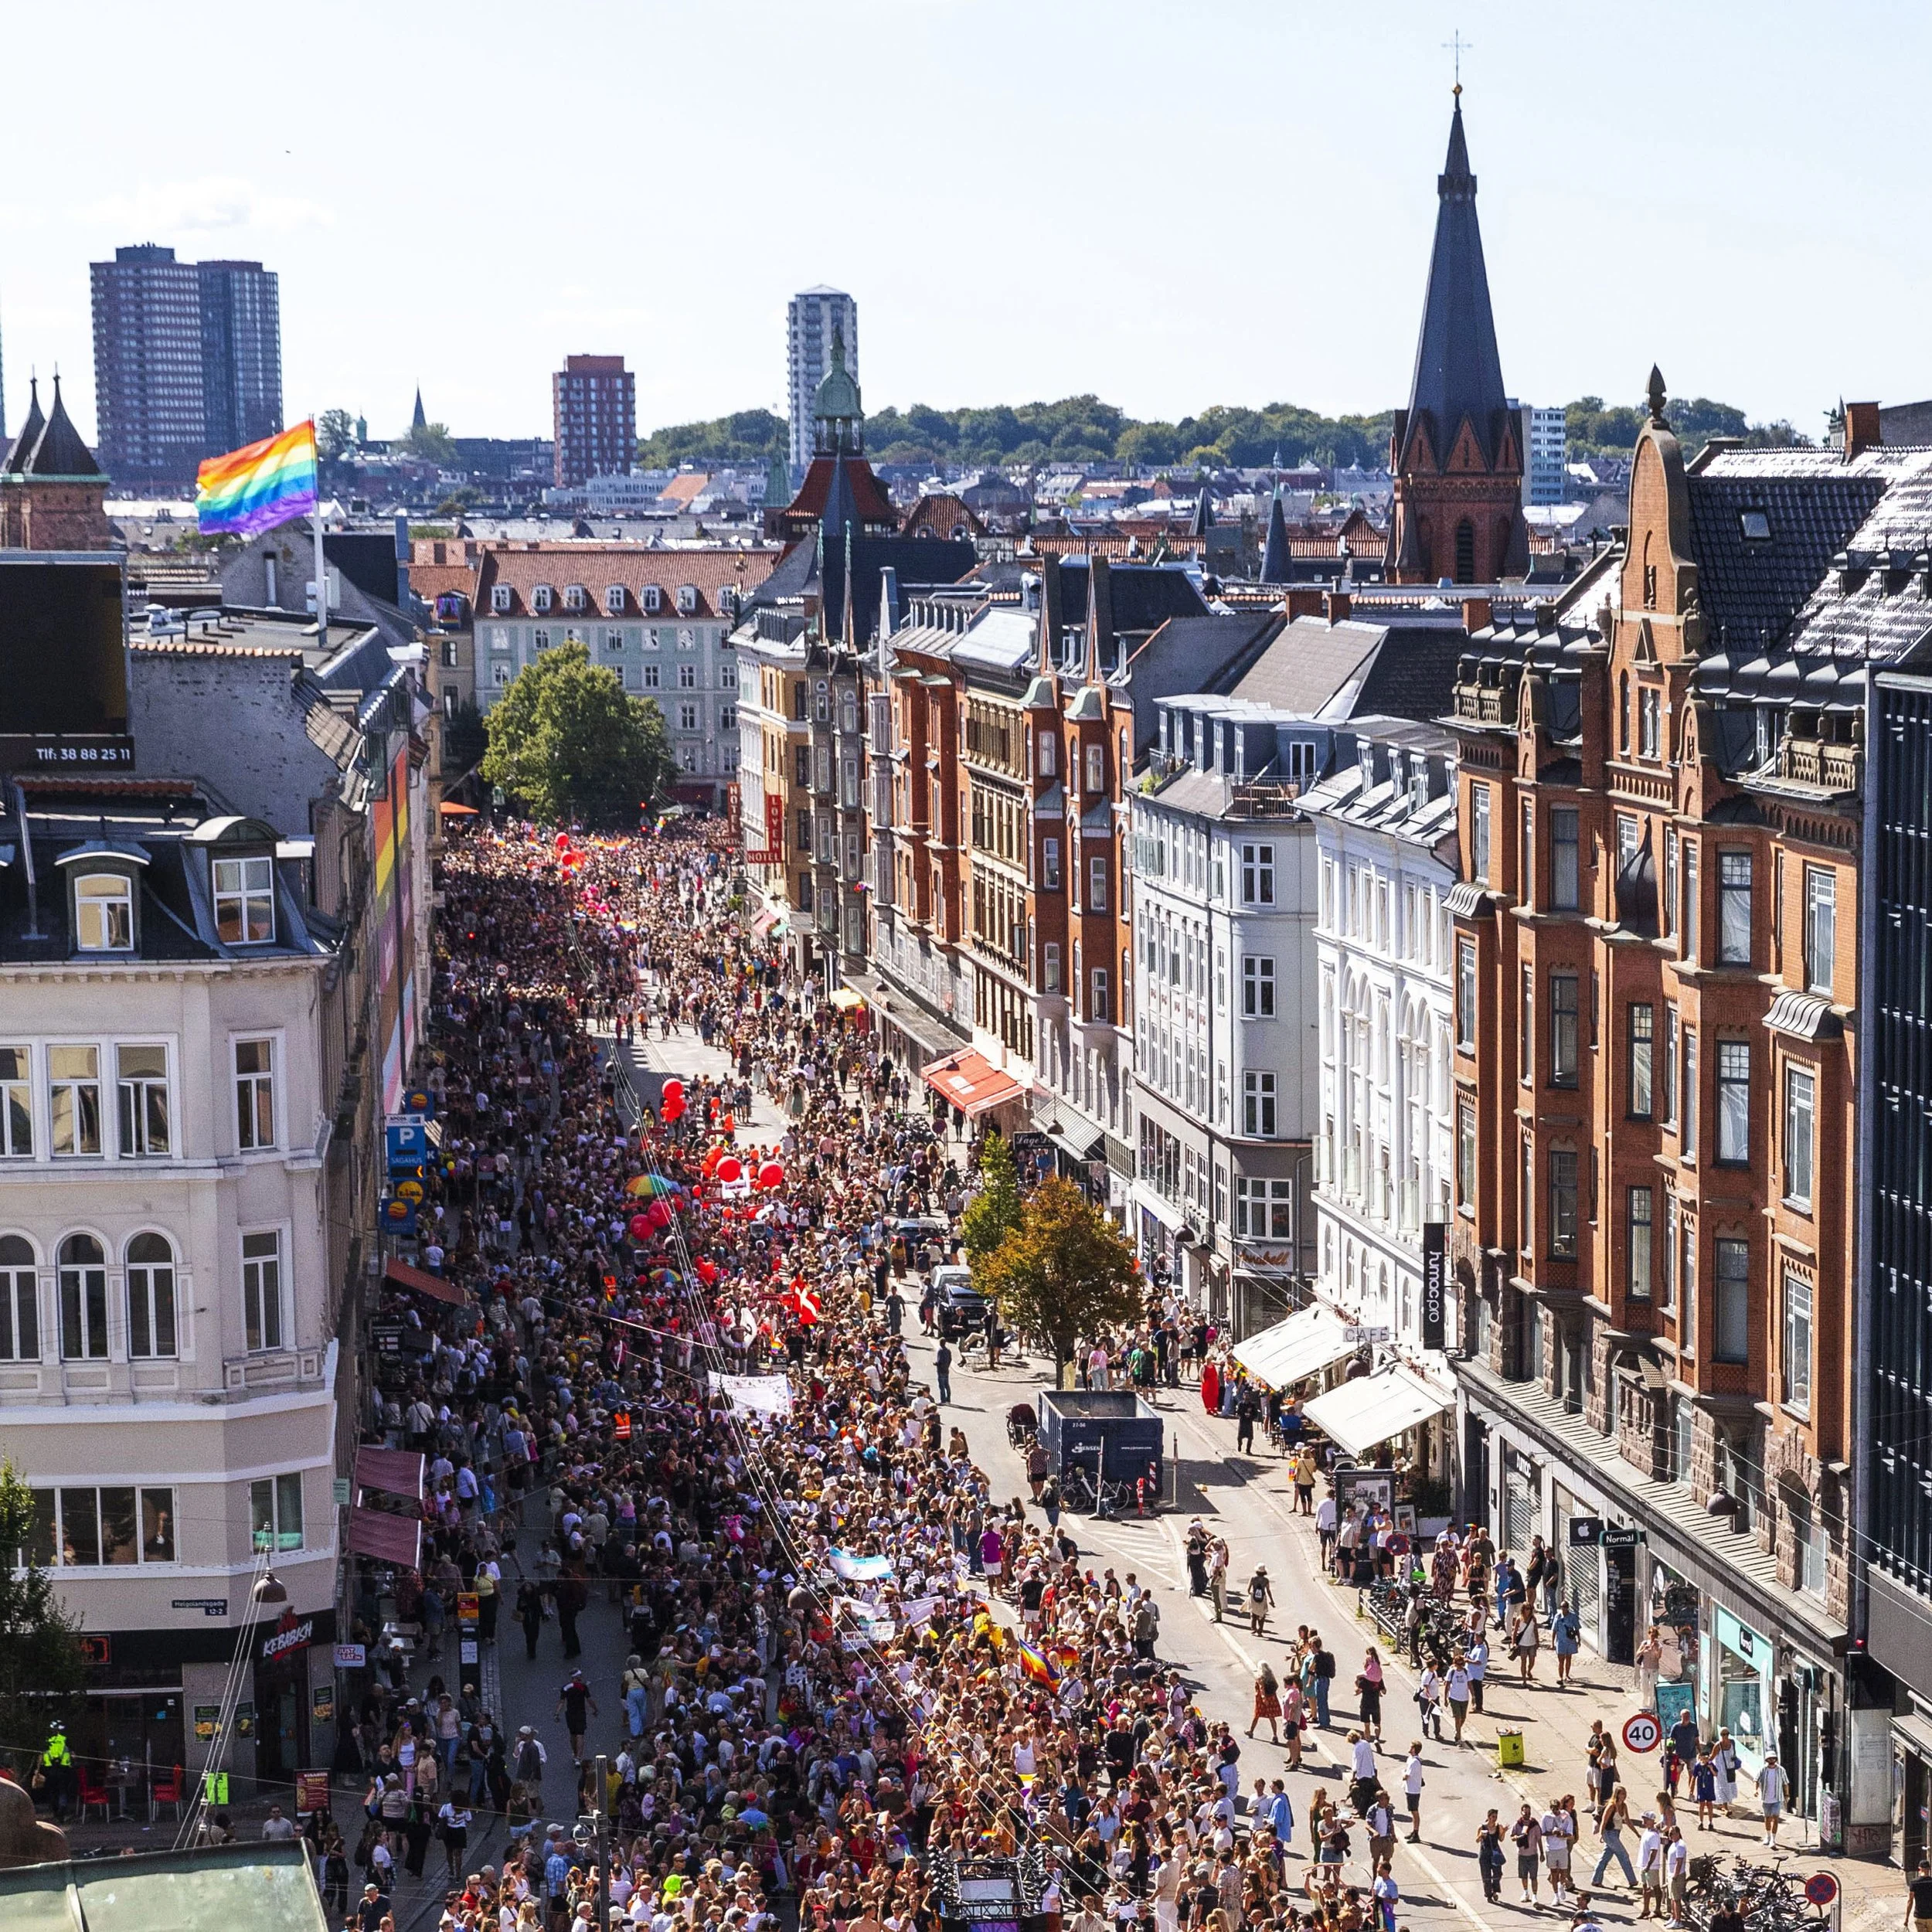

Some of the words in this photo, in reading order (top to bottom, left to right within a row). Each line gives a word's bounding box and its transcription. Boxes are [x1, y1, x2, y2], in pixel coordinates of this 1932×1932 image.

[60, 748, 77, 760] 38
[80, 748, 97, 760] 88
[101, 748, 117, 760] 25
[121, 748, 130, 760] 11
[730, 786, 738, 833] HOTEL
[747, 852, 780, 862] HOTEL
[400, 1128, 415, 1145] P
[263, 1621, 312, 1657] KEBABISH
[1628, 1726, 1655, 1741] 40
